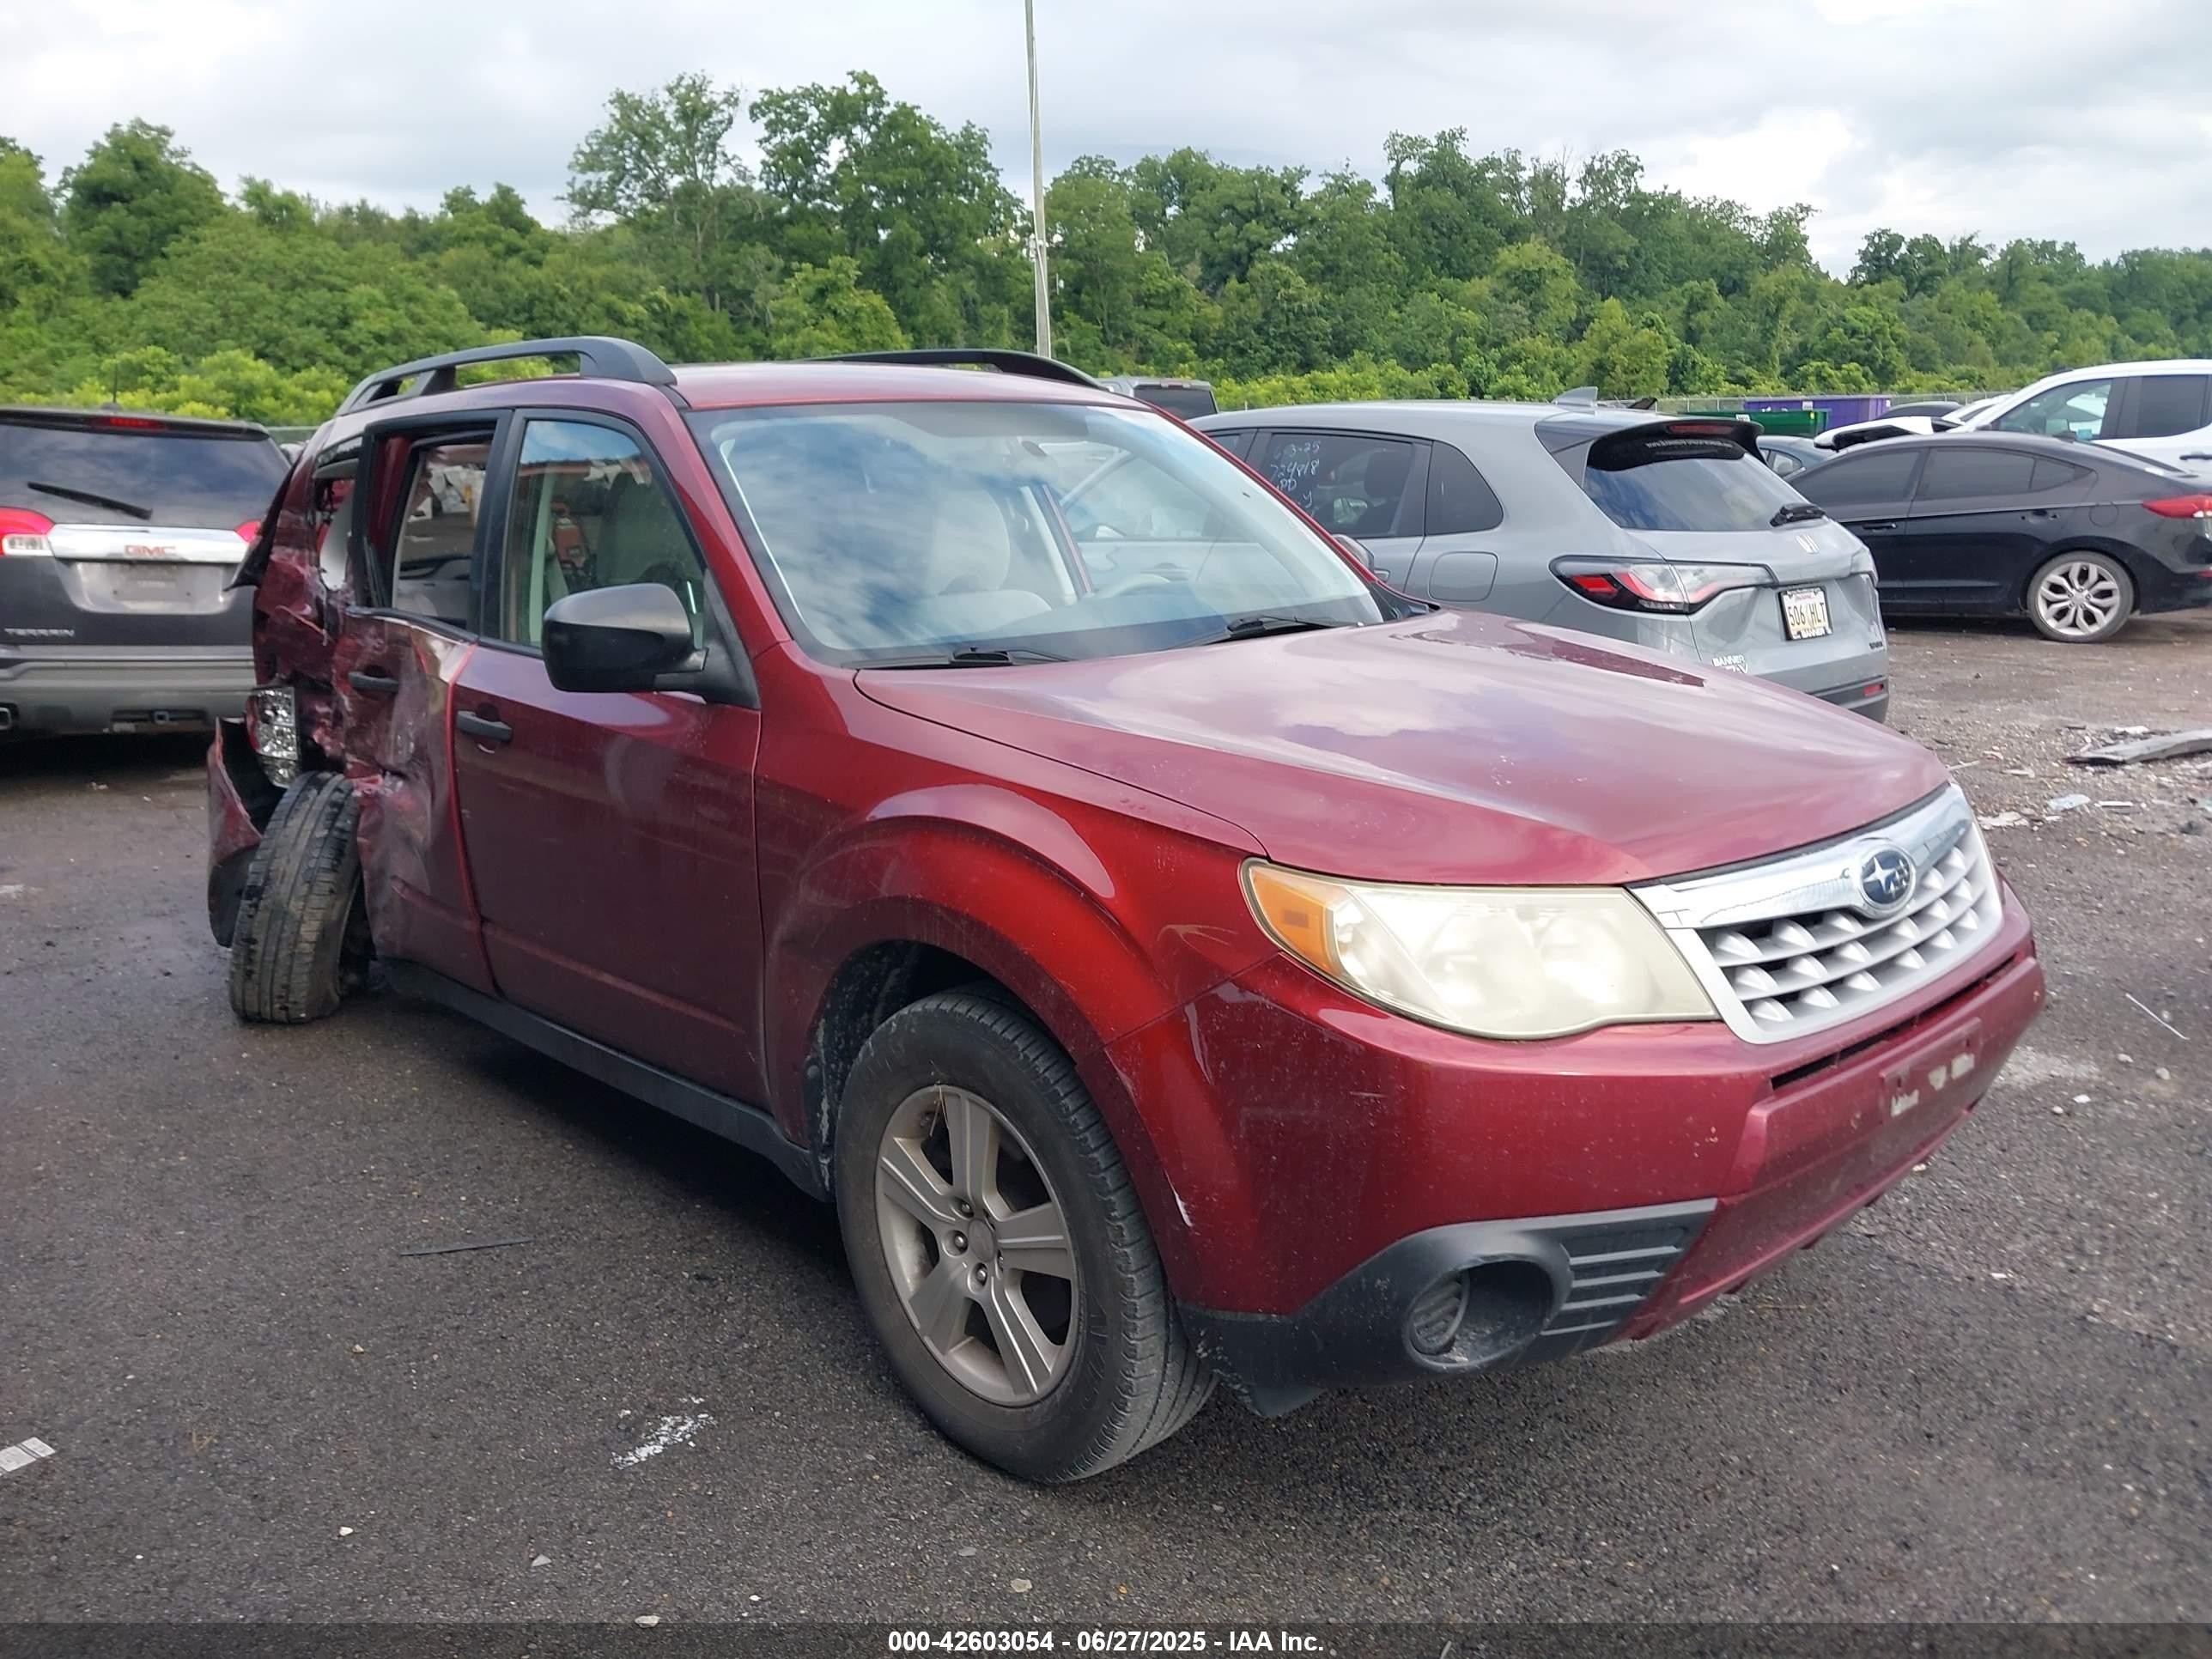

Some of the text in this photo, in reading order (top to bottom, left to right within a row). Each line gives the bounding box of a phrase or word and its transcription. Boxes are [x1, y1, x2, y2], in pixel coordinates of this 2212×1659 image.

[124, 544, 177, 557] GMC
[1787, 602, 1826, 626] 506 HLT
